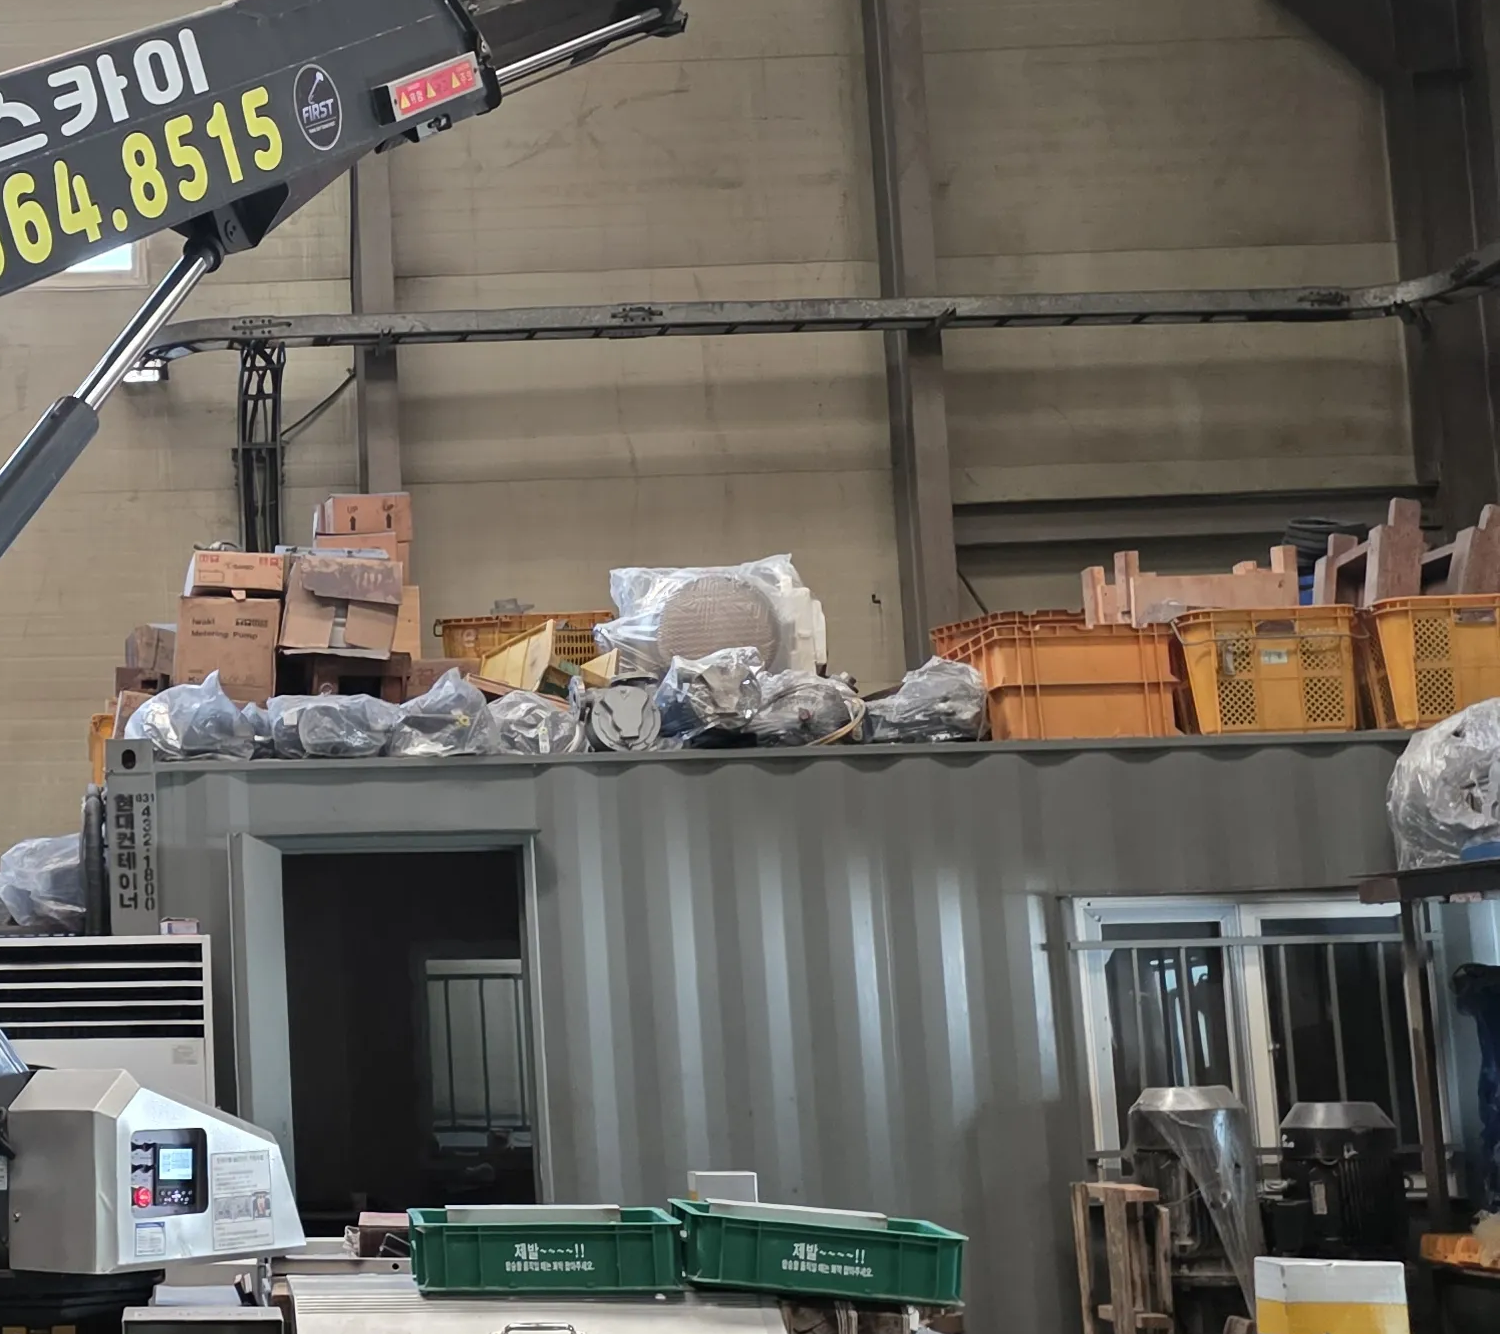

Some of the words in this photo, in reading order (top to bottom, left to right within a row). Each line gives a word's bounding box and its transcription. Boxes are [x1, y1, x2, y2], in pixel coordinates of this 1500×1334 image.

[302, 98, 334, 124] FIRST
[233, 631, 258, 640] Pump
[114, 793, 138, 910] 현대컨테이너
